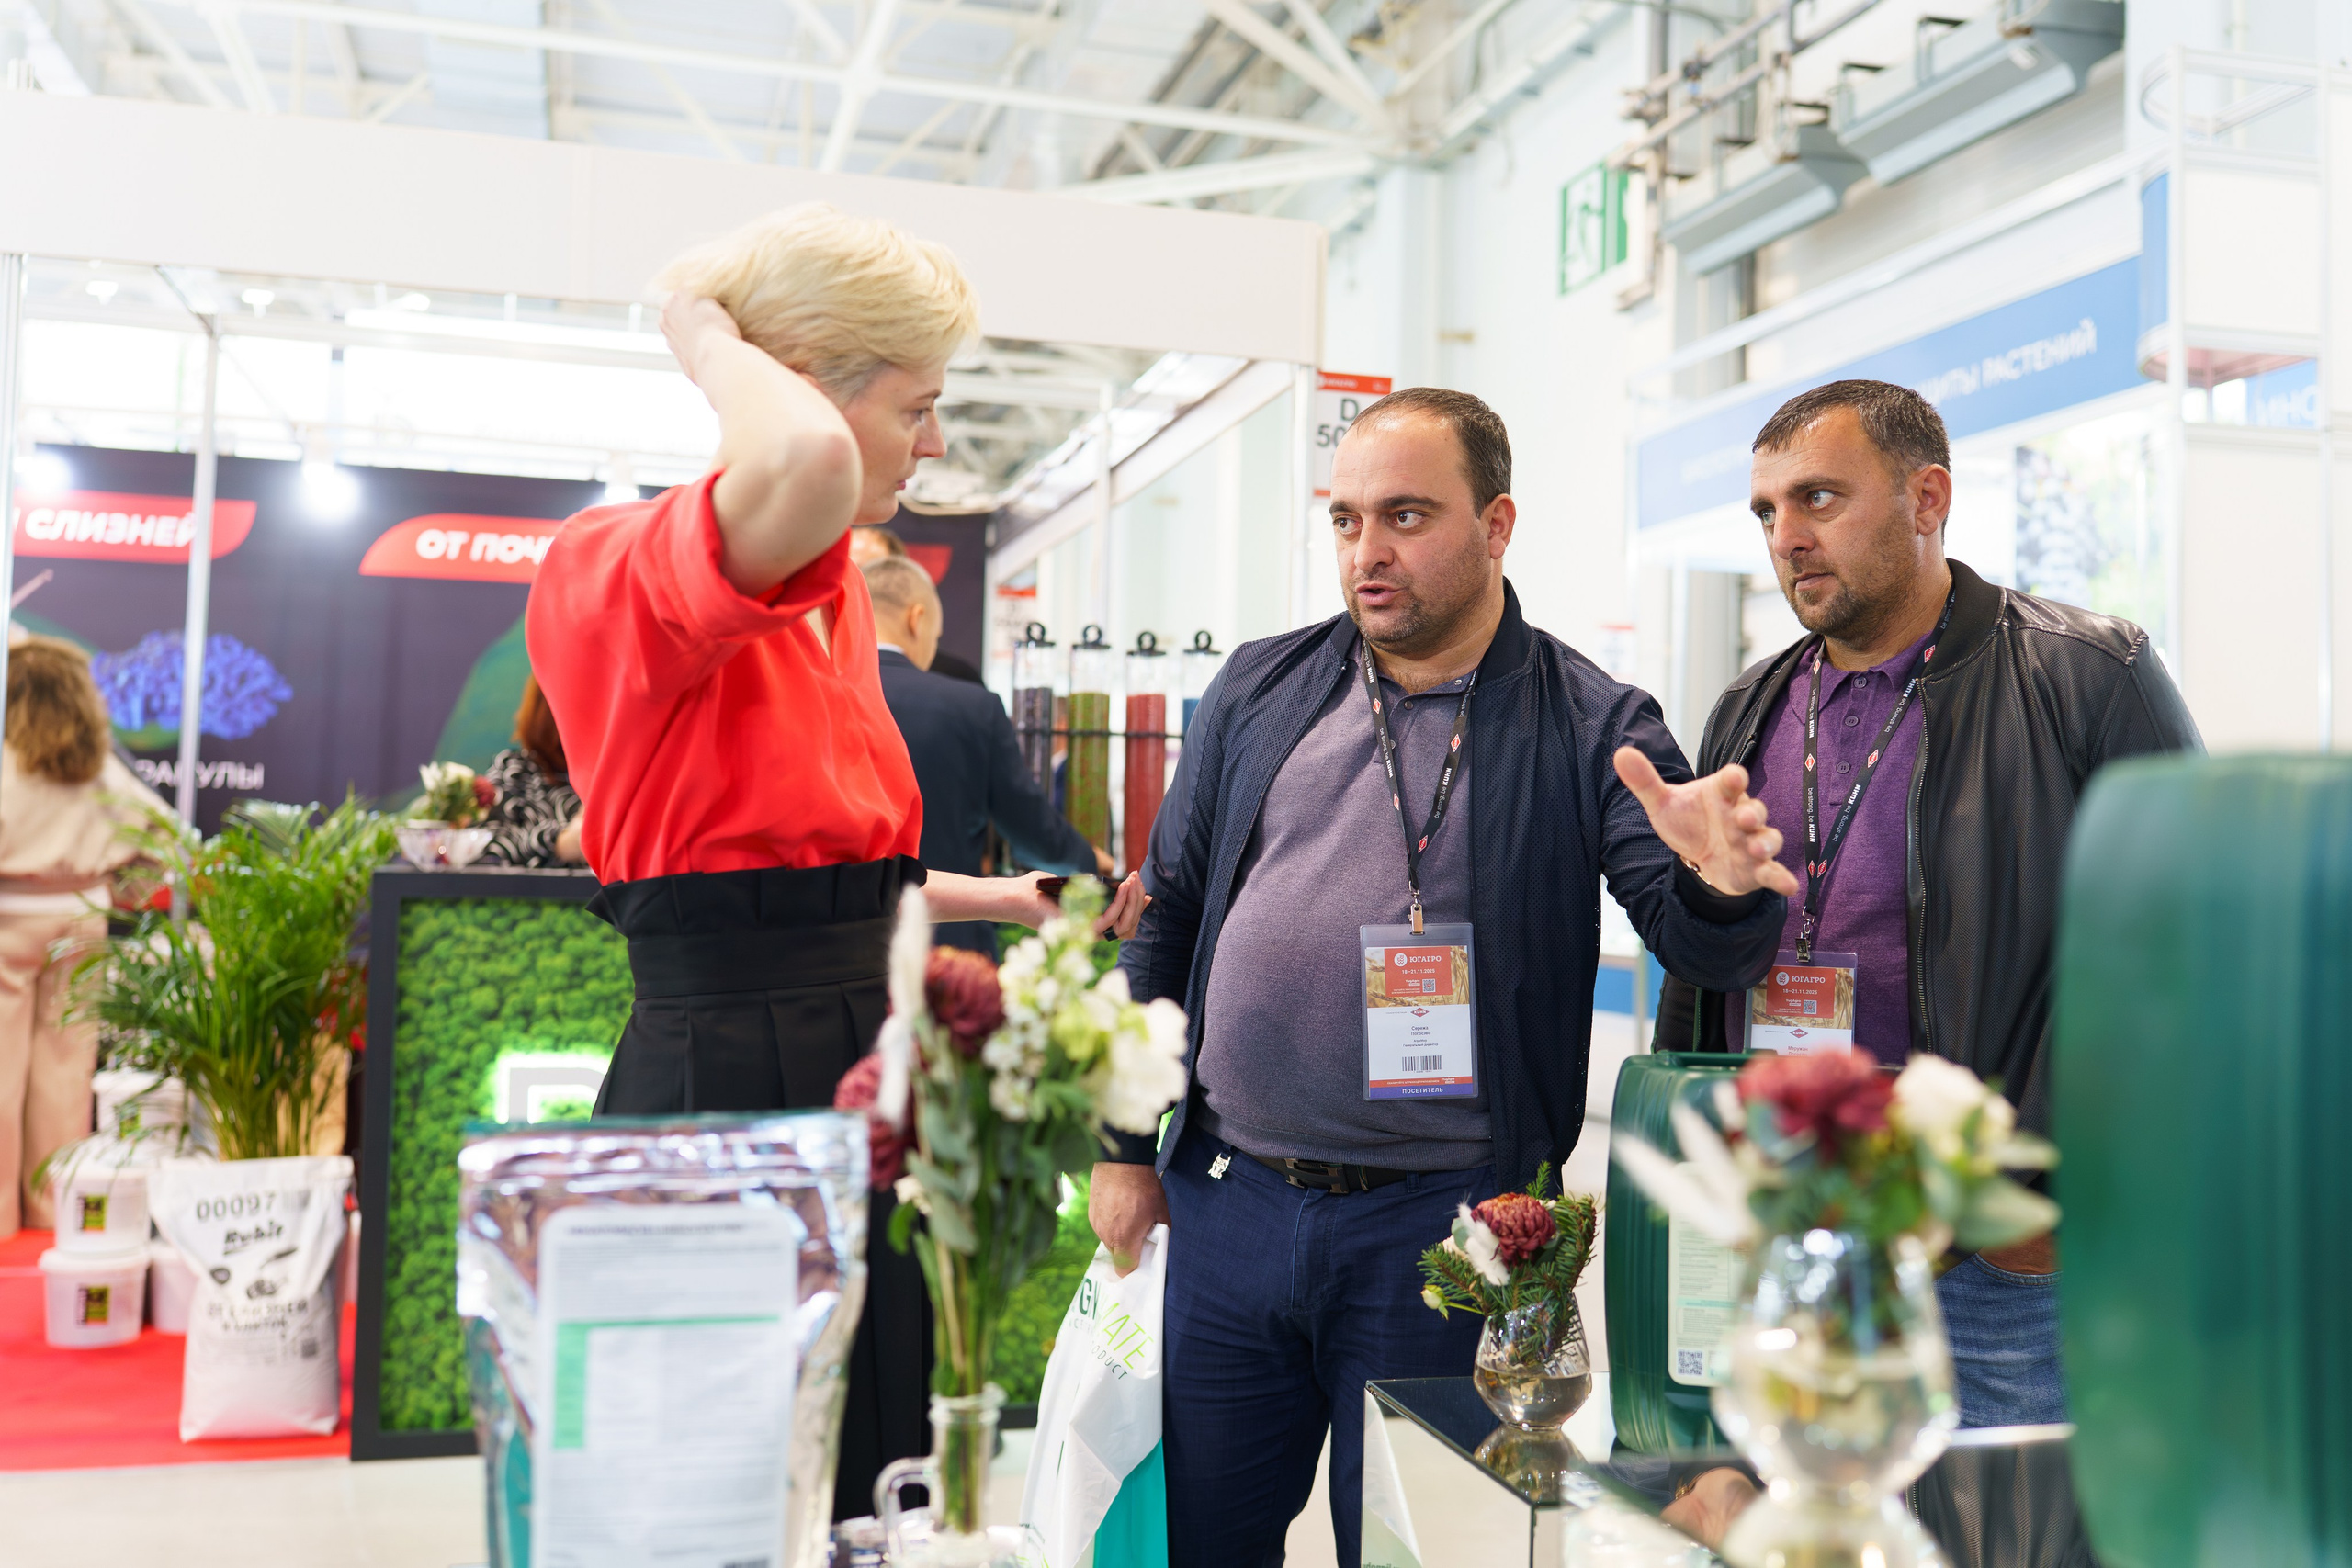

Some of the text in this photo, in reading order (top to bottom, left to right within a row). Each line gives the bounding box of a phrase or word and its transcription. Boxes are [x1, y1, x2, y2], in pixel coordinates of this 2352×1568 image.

[1340, 398, 1360, 422] D
[415, 528, 470, 560] ОТ
[1366, 667, 1375, 683] KUHN
[1903, 678, 1917, 698] KUHN
[135, 759, 265, 790] РАУЛЫ
[1385, 760, 1394, 779] KUHN
[1442, 767, 1453, 786] KUHN
[1847, 784, 1861, 806] KUHN
[1808, 823, 1816, 843] KUHN
[1792, 976, 1826, 984] ЮГАГРО
